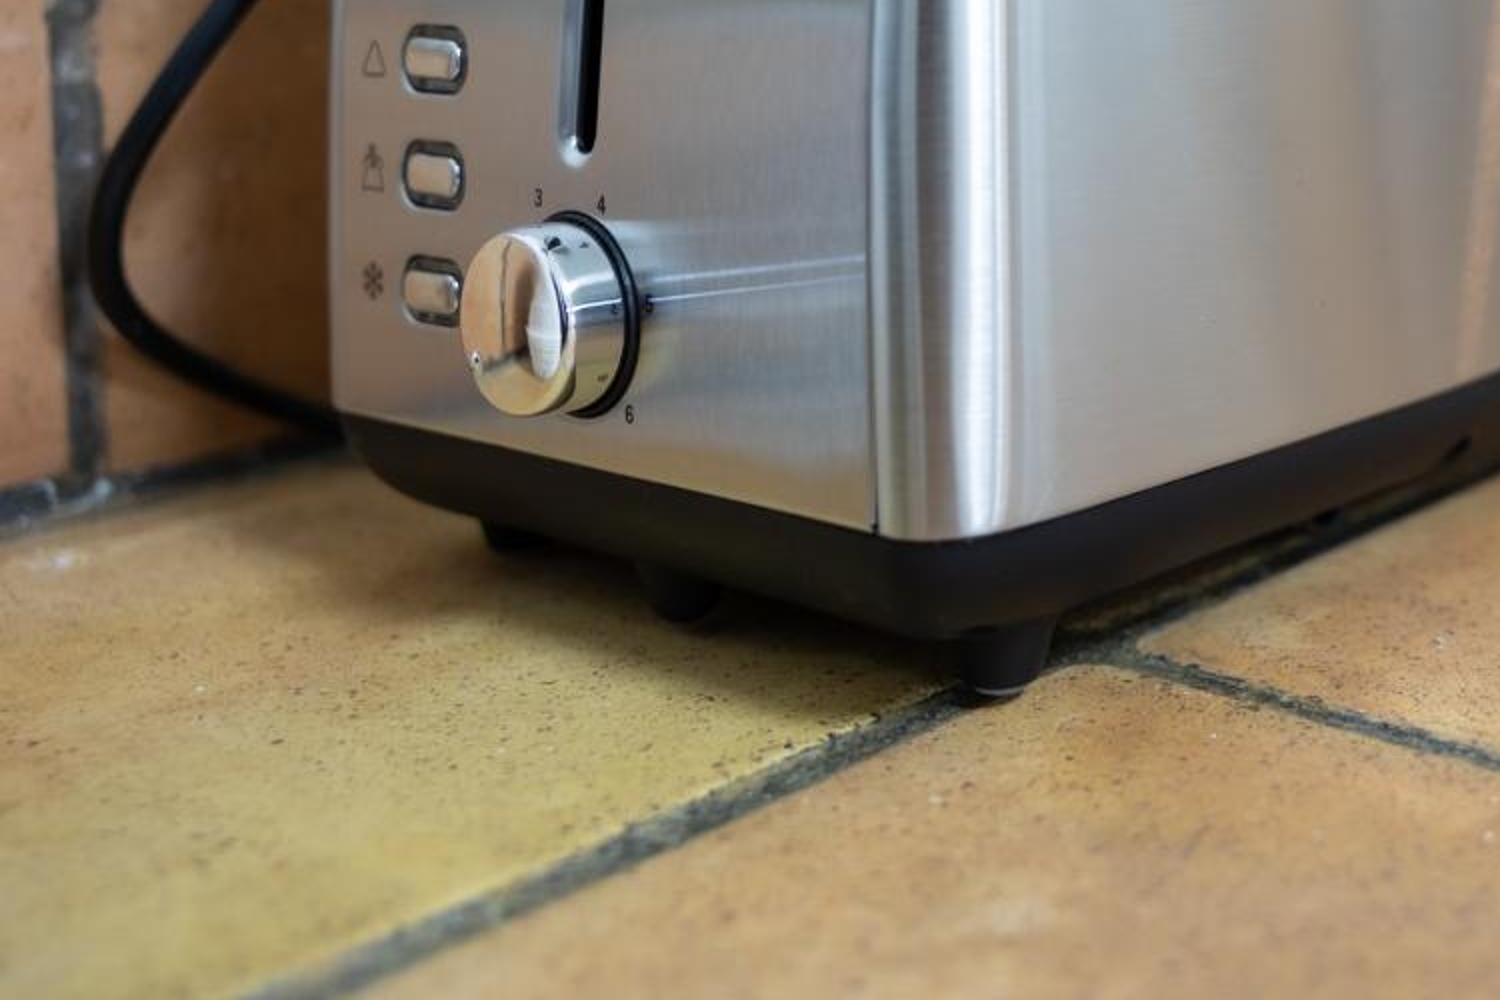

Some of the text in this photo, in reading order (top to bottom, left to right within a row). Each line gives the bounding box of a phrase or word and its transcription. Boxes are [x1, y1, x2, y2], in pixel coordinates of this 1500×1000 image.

[534, 187, 543, 207] 3
[597, 194, 606, 215] 4
[625, 404, 635, 424] 6
